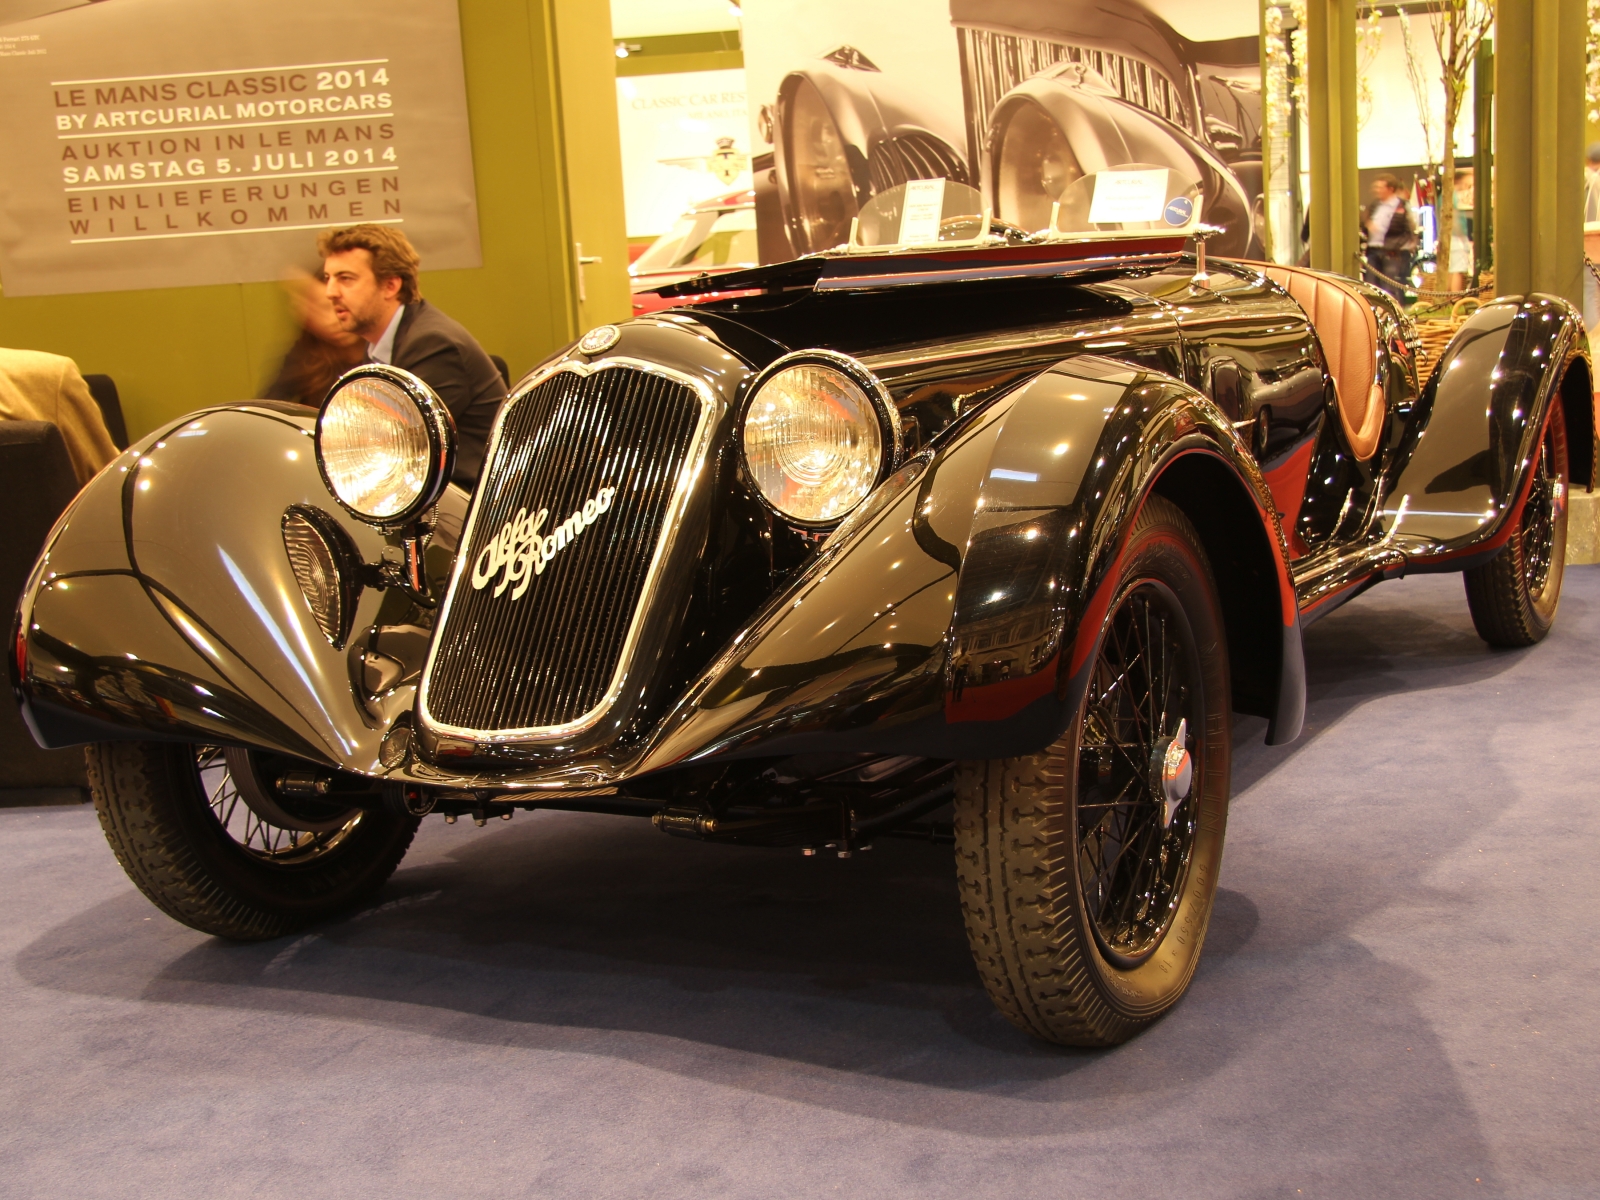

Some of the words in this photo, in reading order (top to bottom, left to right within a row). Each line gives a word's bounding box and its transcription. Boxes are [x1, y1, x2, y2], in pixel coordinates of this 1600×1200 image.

[54, 89, 87, 108] LE
[95, 83, 178, 106] MANS
[186, 74, 308, 100] CLASSIC
[316, 67, 390, 91] 2014
[631, 96, 687, 110] CLASSIC
[688, 93, 718, 105] CAR
[56, 113, 88, 131] BY
[94, 104, 232, 129] ARTCURIAL
[236, 93, 393, 119] MOTORCARS
[61, 137, 201, 161] AUKTION
[215, 134, 245, 151] IN
[259, 131, 293, 148] LE
[305, 123, 395, 145] MANS
[63, 158, 206, 184] SAMSTAG
[216, 158, 242, 174] 5.
[251, 151, 314, 172] JULI
[325, 146, 397, 167] 2014
[67, 176, 400, 214] EINLIEFERUNGEN
[69, 199, 401, 236] WILLKOMMEN
[472, 507, 549, 598] Alfa
[508, 486, 616, 601] Romeo
[1200, 641, 1225, 834] MICHELIN
